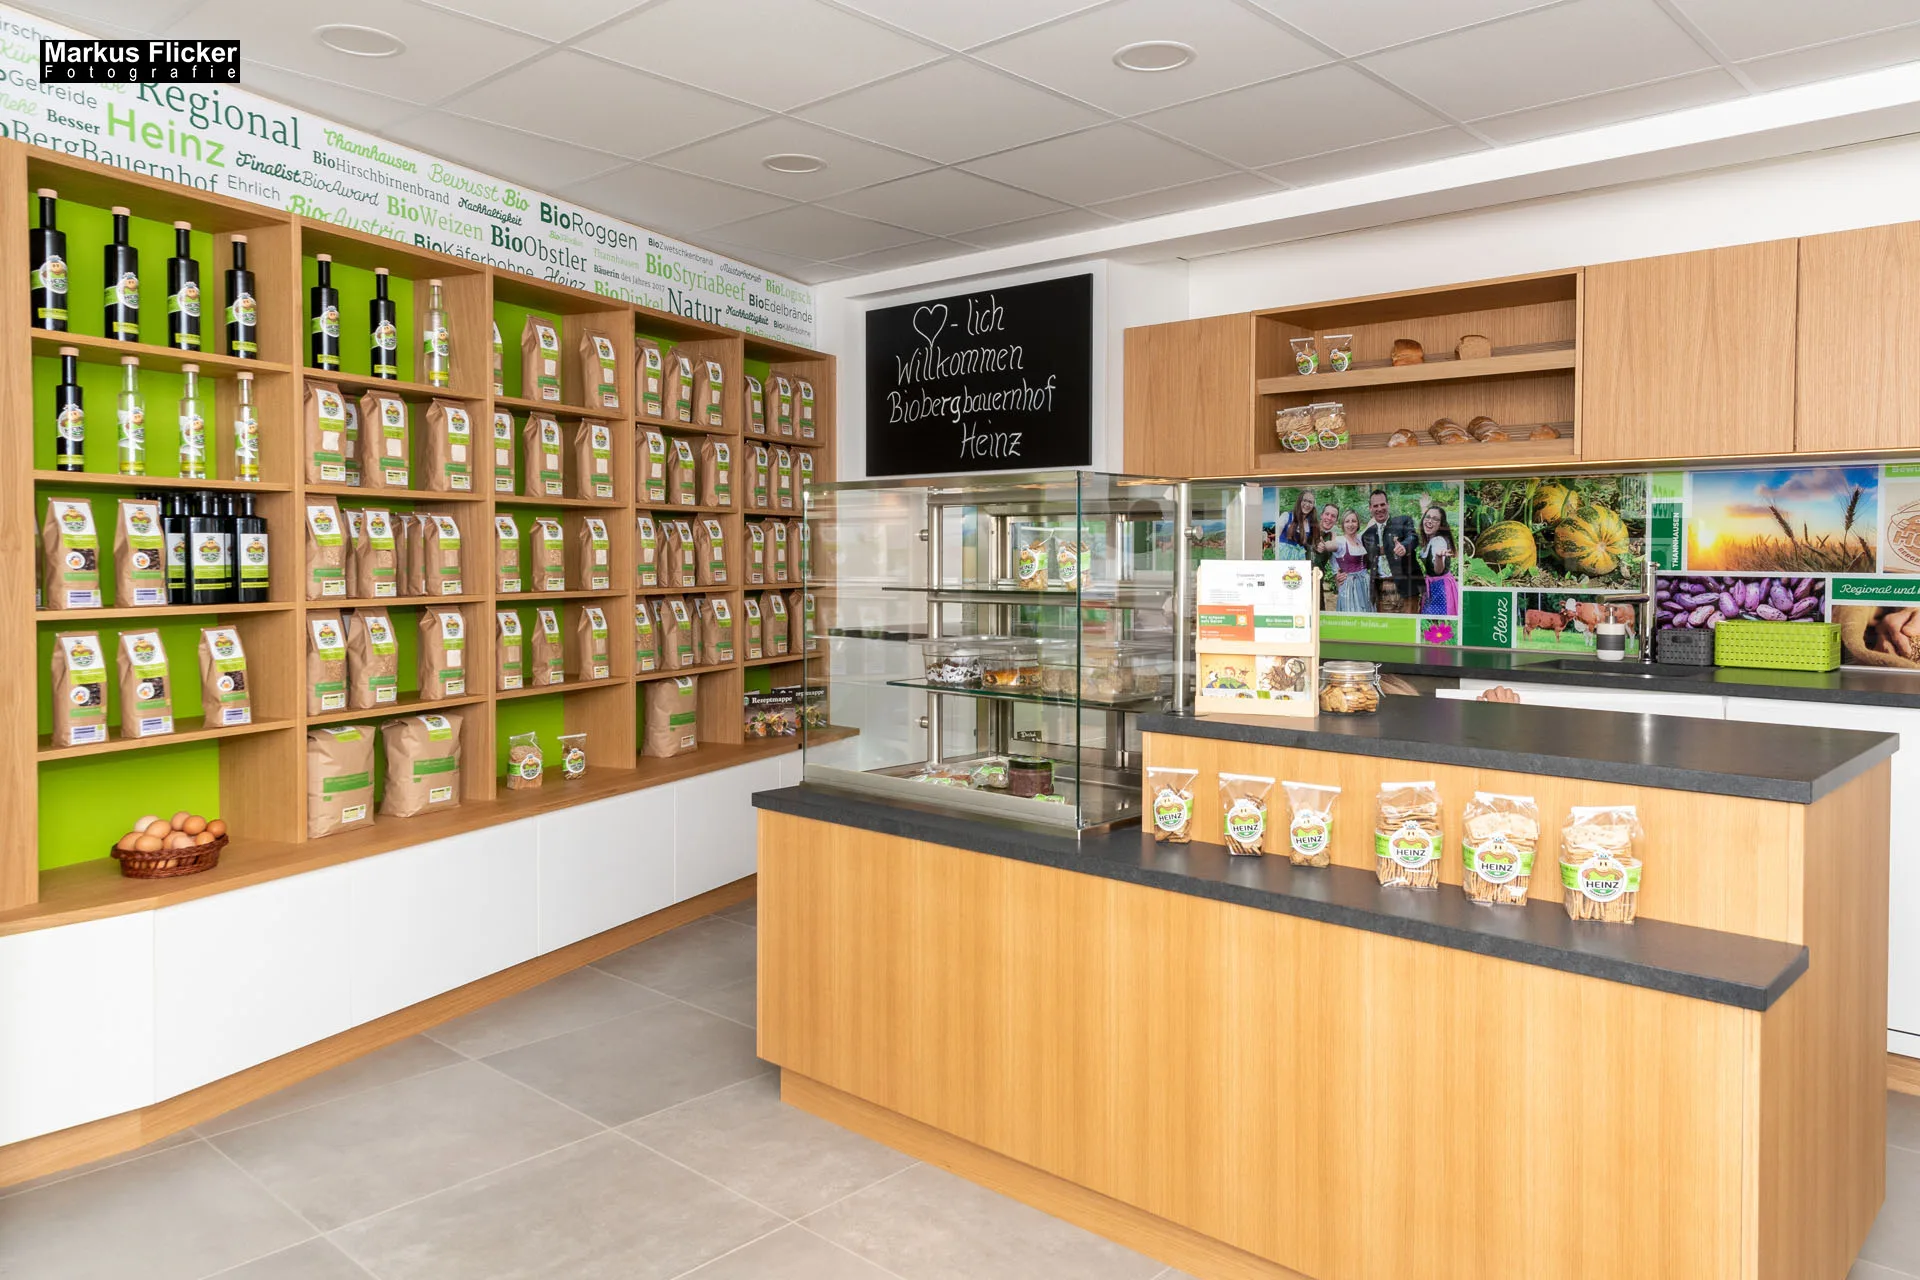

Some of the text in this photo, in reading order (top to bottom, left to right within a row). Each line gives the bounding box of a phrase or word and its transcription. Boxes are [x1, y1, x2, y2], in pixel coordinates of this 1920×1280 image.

[47, 108, 101, 136] Besser
[136, 83, 301, 150] Regional
[107, 102, 226, 168] Heinz
[227, 174, 281, 201] Ehrlich
[312, 150, 450, 205] BioHirschbirnenbrand
[427, 163, 530, 212] Bewusst Bio
[386, 194, 484, 242] BioWeizen
[457, 196, 523, 227] Nachhaltigkeit
[540, 201, 638, 252] BioRoggen
[490, 224, 588, 274] BioObstler
[593, 264, 620, 280] Bäuerin
[645, 252, 746, 302] BioStyriaBeef
[667, 287, 723, 327] Natur
[725, 304, 769, 327] Nachhaltigkeit
[748, 293, 814, 325] BioEdelbrände
[895, 344, 1024, 386] Willkommen
[886, 373, 1057, 424] Biobergbauernhof
[959, 419, 1024, 460] Heinz
[1671, 511, 1680, 569] THANNHAUSEN
[1839, 583, 1892, 595] Regional
[1894, 584, 1916, 595] und
[1492, 596, 1509, 645] Heinz
[751, 695, 793, 704] Rezeptmappe
[1158, 811, 1183, 822] HEINZ
[1232, 823, 1259, 832] HEINZ
[1295, 834, 1323, 845] HEINZ
[1396, 847, 1426, 857] HEINZ
[1480, 862, 1514, 873] HEINZ
[1585, 880, 1620, 890] HEINZ
